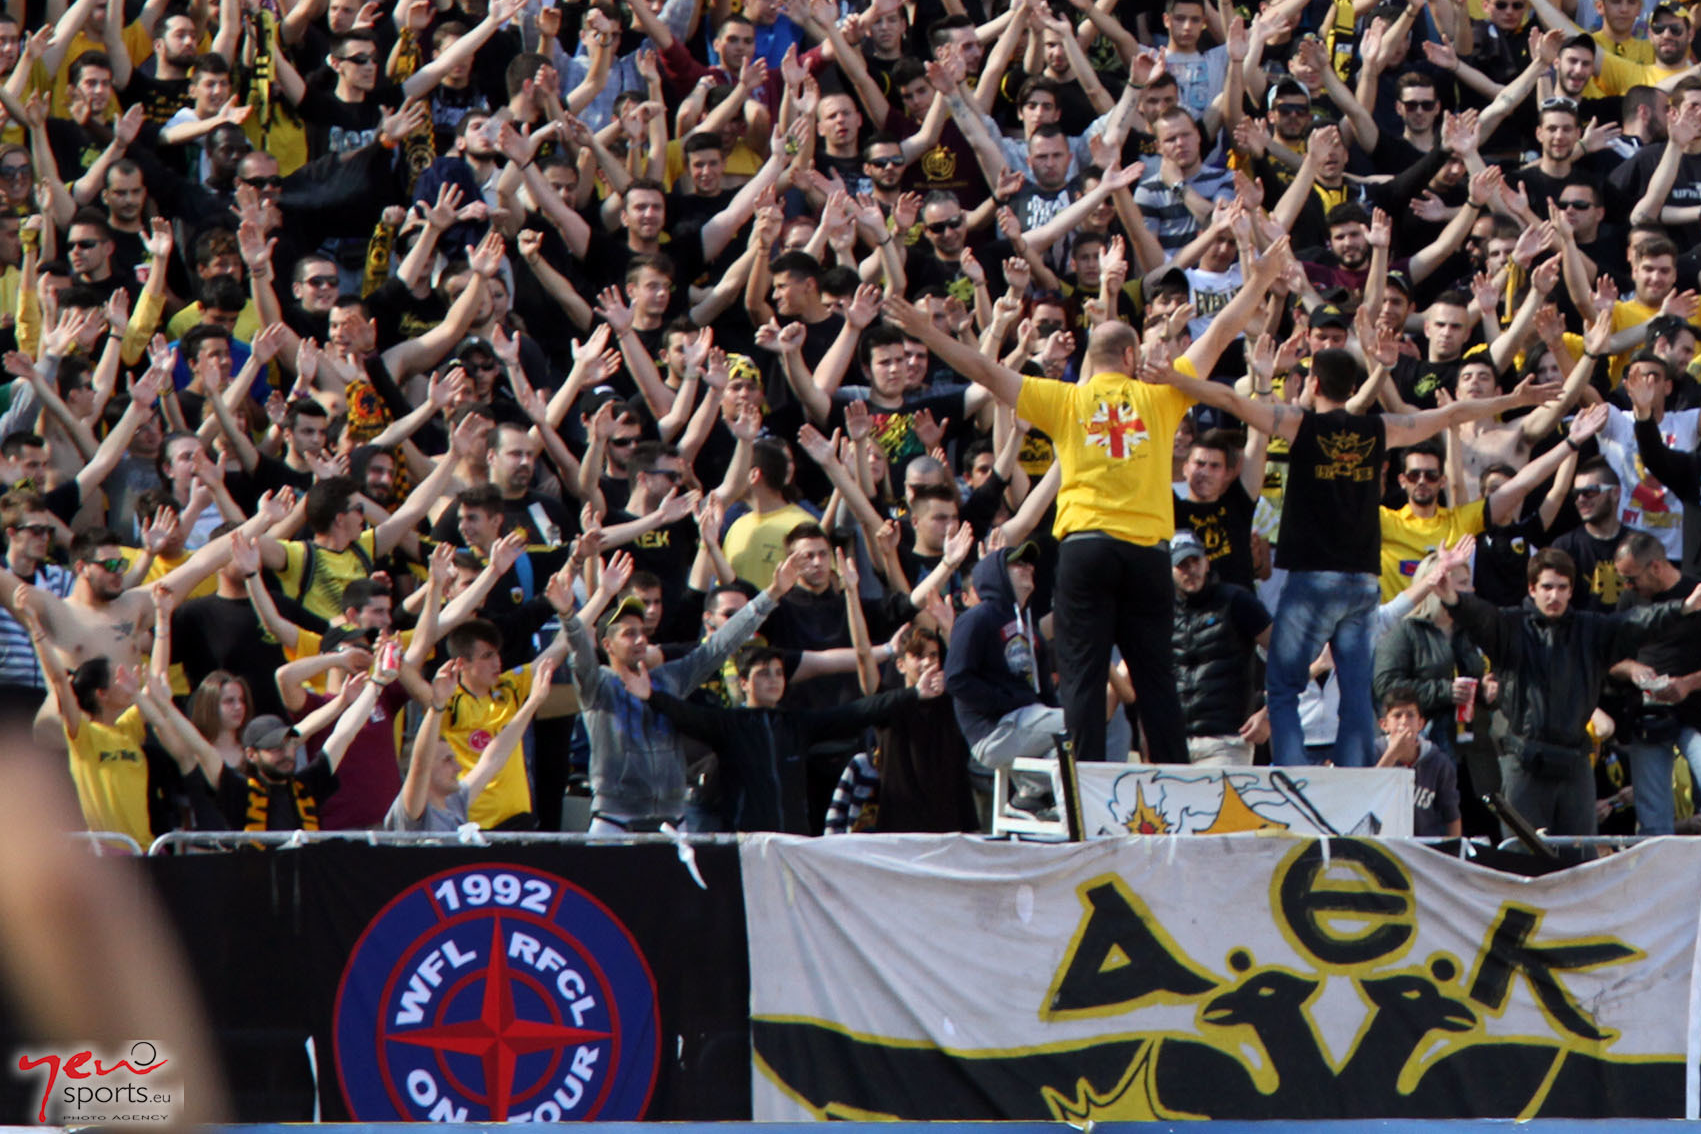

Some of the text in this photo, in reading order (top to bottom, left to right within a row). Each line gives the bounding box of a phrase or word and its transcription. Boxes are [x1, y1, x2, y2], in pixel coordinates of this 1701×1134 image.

[435, 874, 552, 914] 1992
[396, 931, 596, 1028] WFL RFCL
